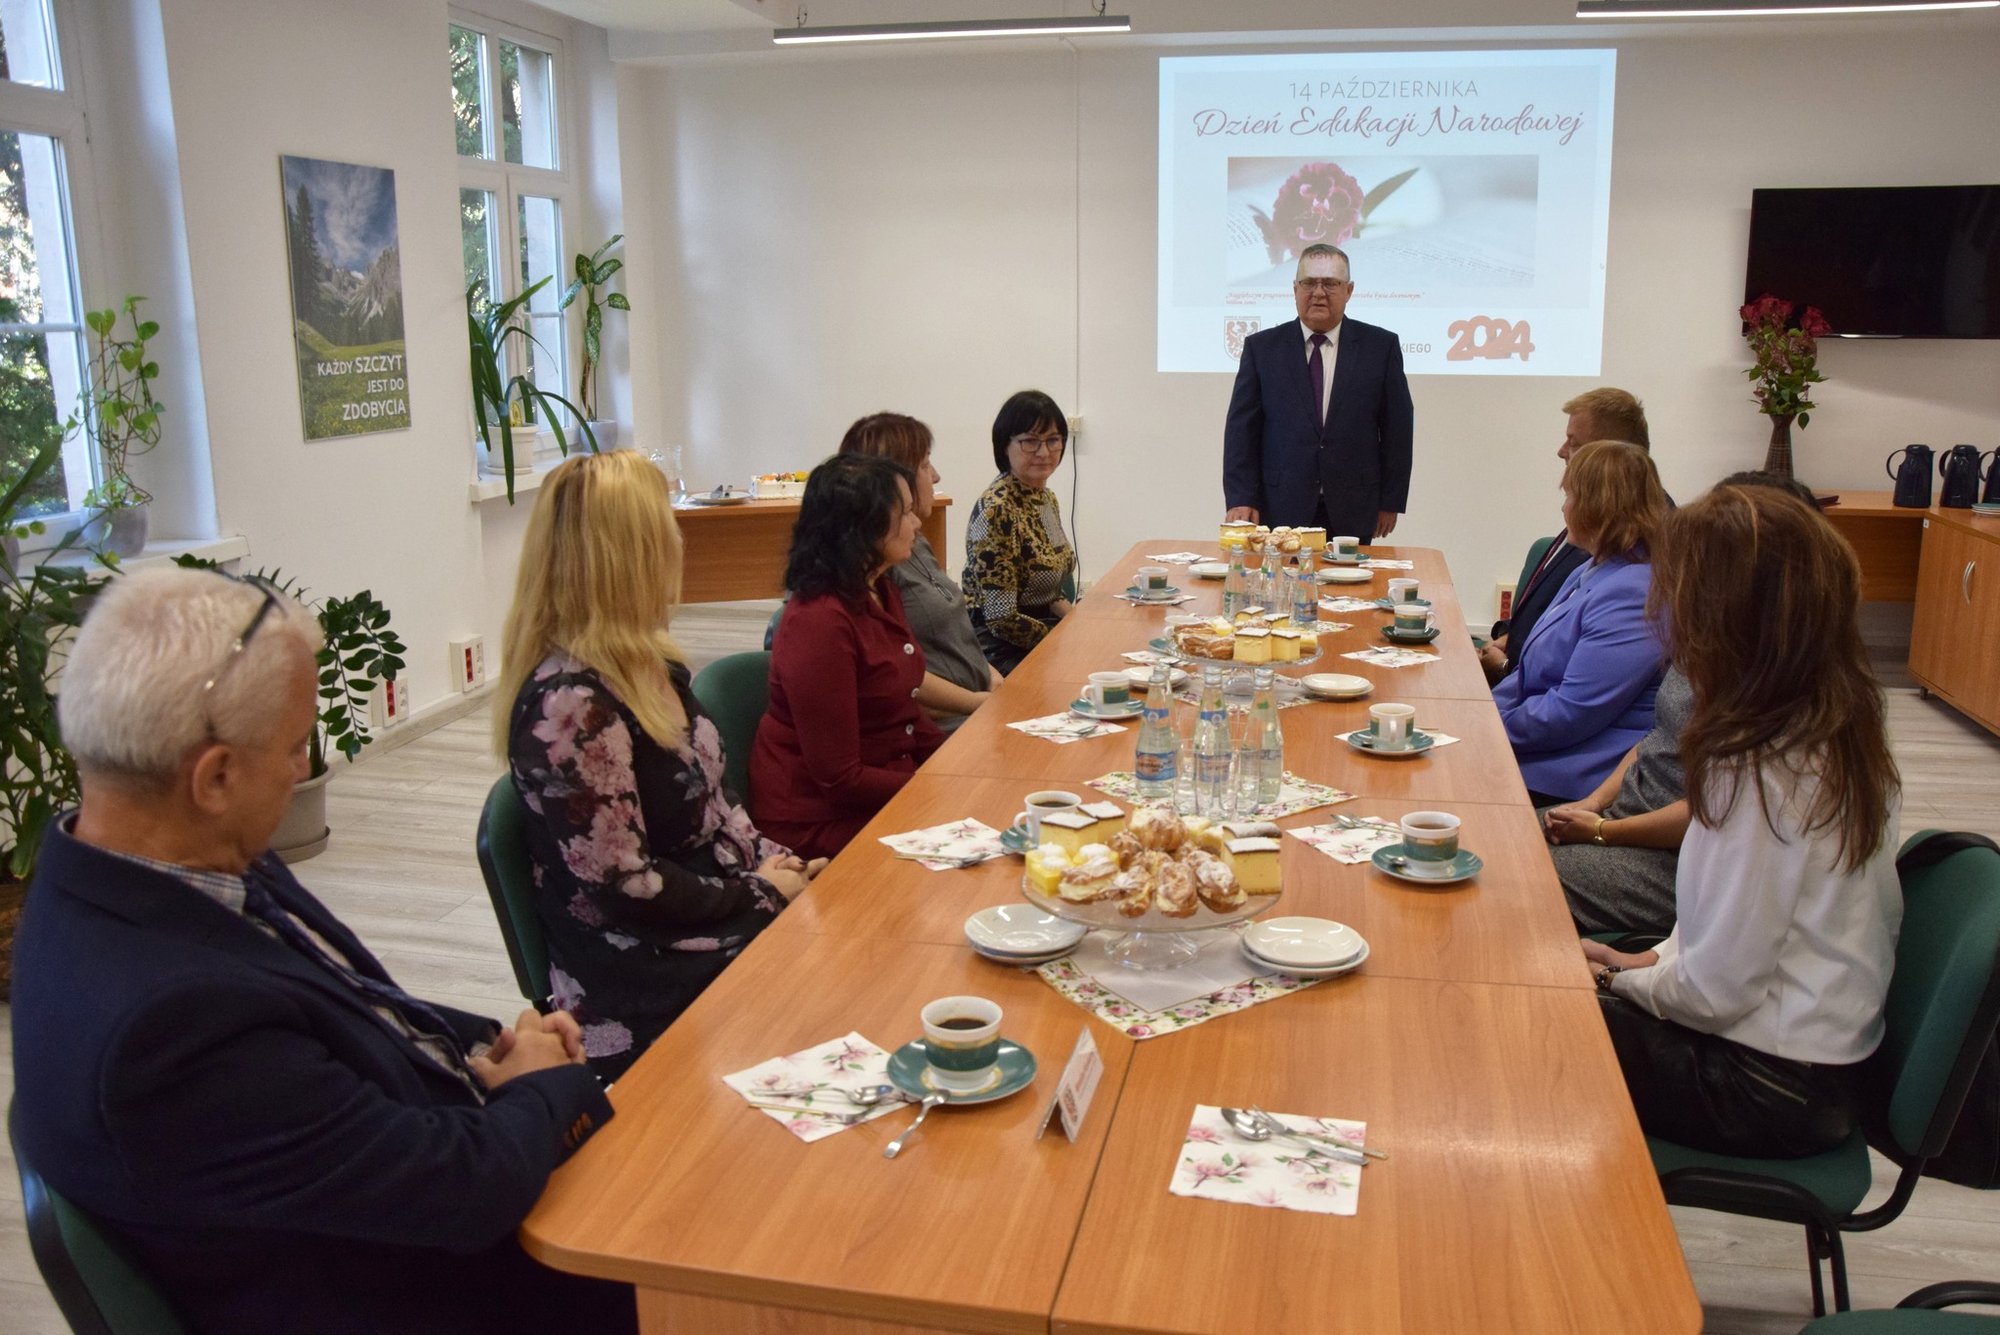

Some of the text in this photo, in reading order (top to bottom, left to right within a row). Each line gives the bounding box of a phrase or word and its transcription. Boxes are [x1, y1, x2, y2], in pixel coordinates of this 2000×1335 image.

[1289, 75, 1479, 100] 14 PAŹDZIERNIKA
[1192, 104, 1584, 147] Dzień Edukacji Narodowej
[1447, 315, 1536, 361] 2024
[317, 355, 402, 376] KAŻDY SZCZYT
[367, 378, 404, 393] JEST DO
[342, 399, 407, 420] ZDOBYCIA
